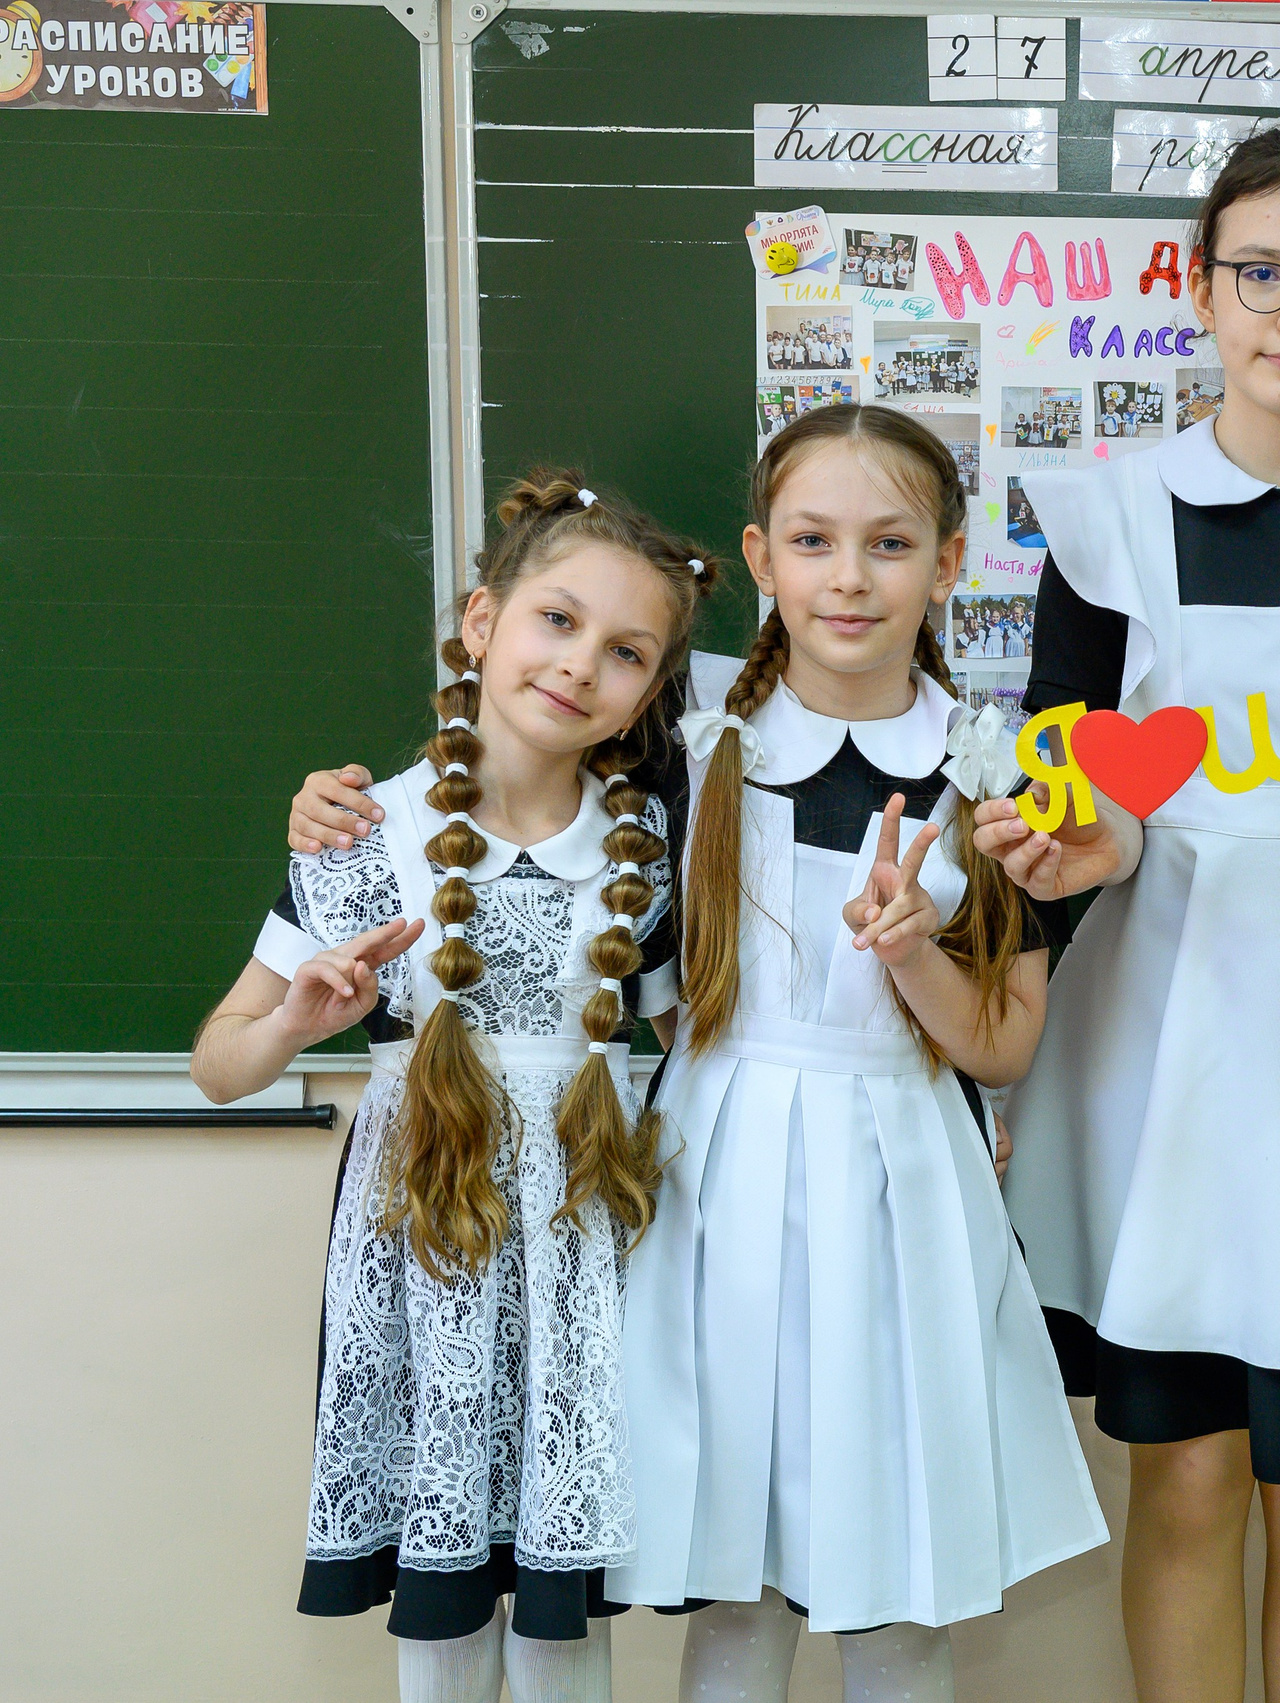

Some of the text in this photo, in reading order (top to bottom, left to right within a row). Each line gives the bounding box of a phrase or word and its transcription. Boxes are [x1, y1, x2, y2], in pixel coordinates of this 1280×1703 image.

[45, 63, 204, 98] УРОКОВ
[773, 104, 1033, 164] Классная
[779, 225, 819, 243] ОРЛЯТА
[925, 230, 1112, 320] НАШ
[778, 282, 841, 301] ТИМА
[1018, 452, 1067, 468] УЛЬЯНА
[984, 553, 1024, 575] Настя
[1015, 701, 1100, 834] Я
